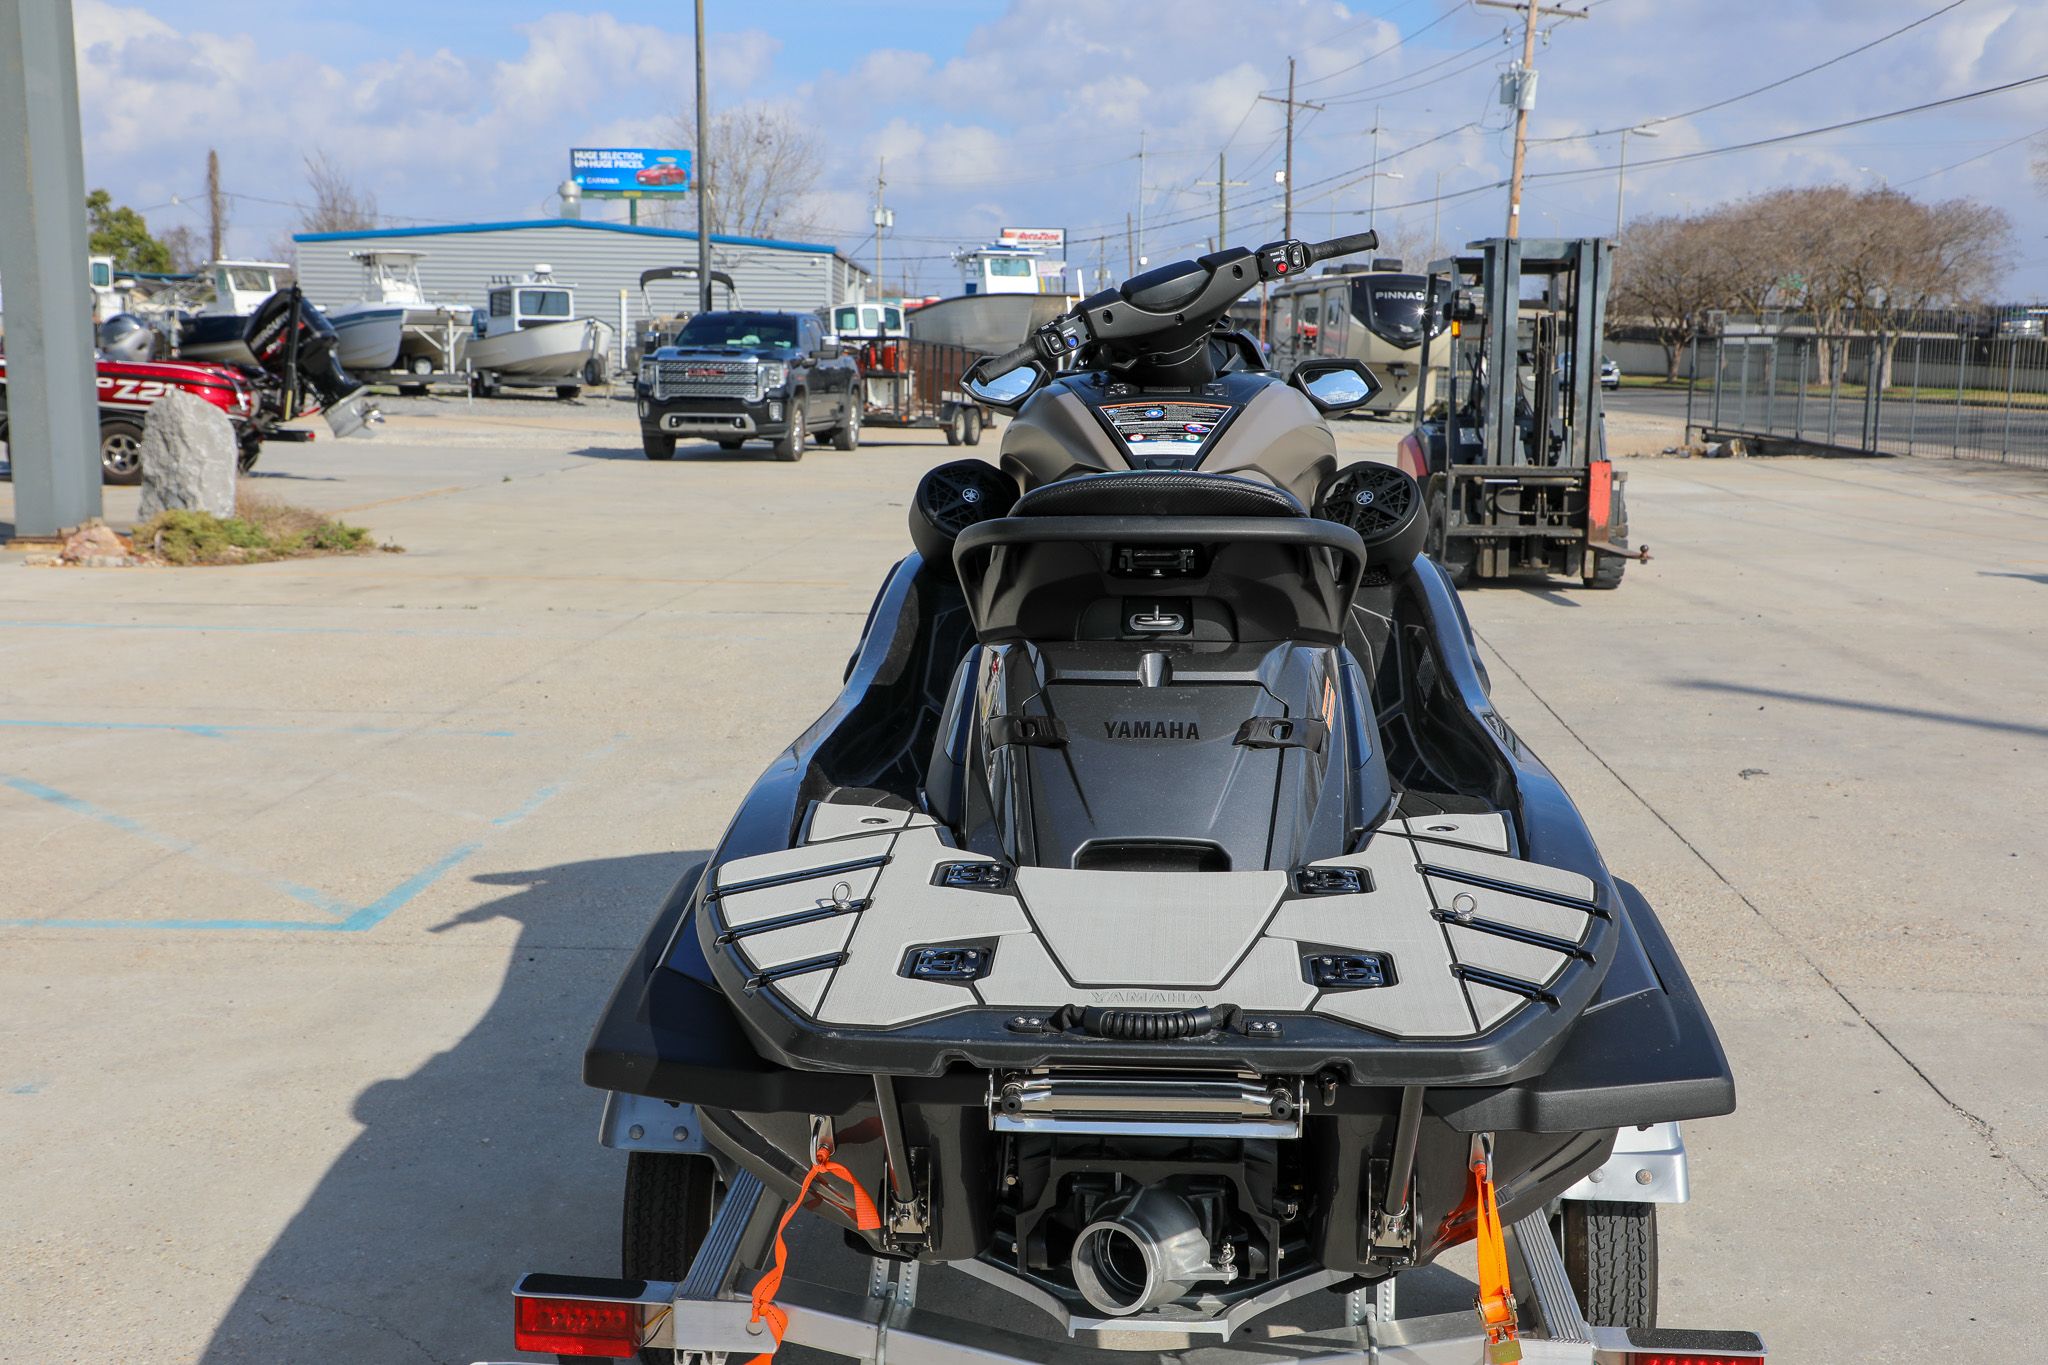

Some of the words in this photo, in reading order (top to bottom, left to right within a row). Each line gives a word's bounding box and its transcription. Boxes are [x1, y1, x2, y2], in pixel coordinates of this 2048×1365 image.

[574, 151, 598, 159] HUGE
[1104, 721, 1200, 740] YAMAHA
[1090, 991, 1205, 1004] YAMAHA
